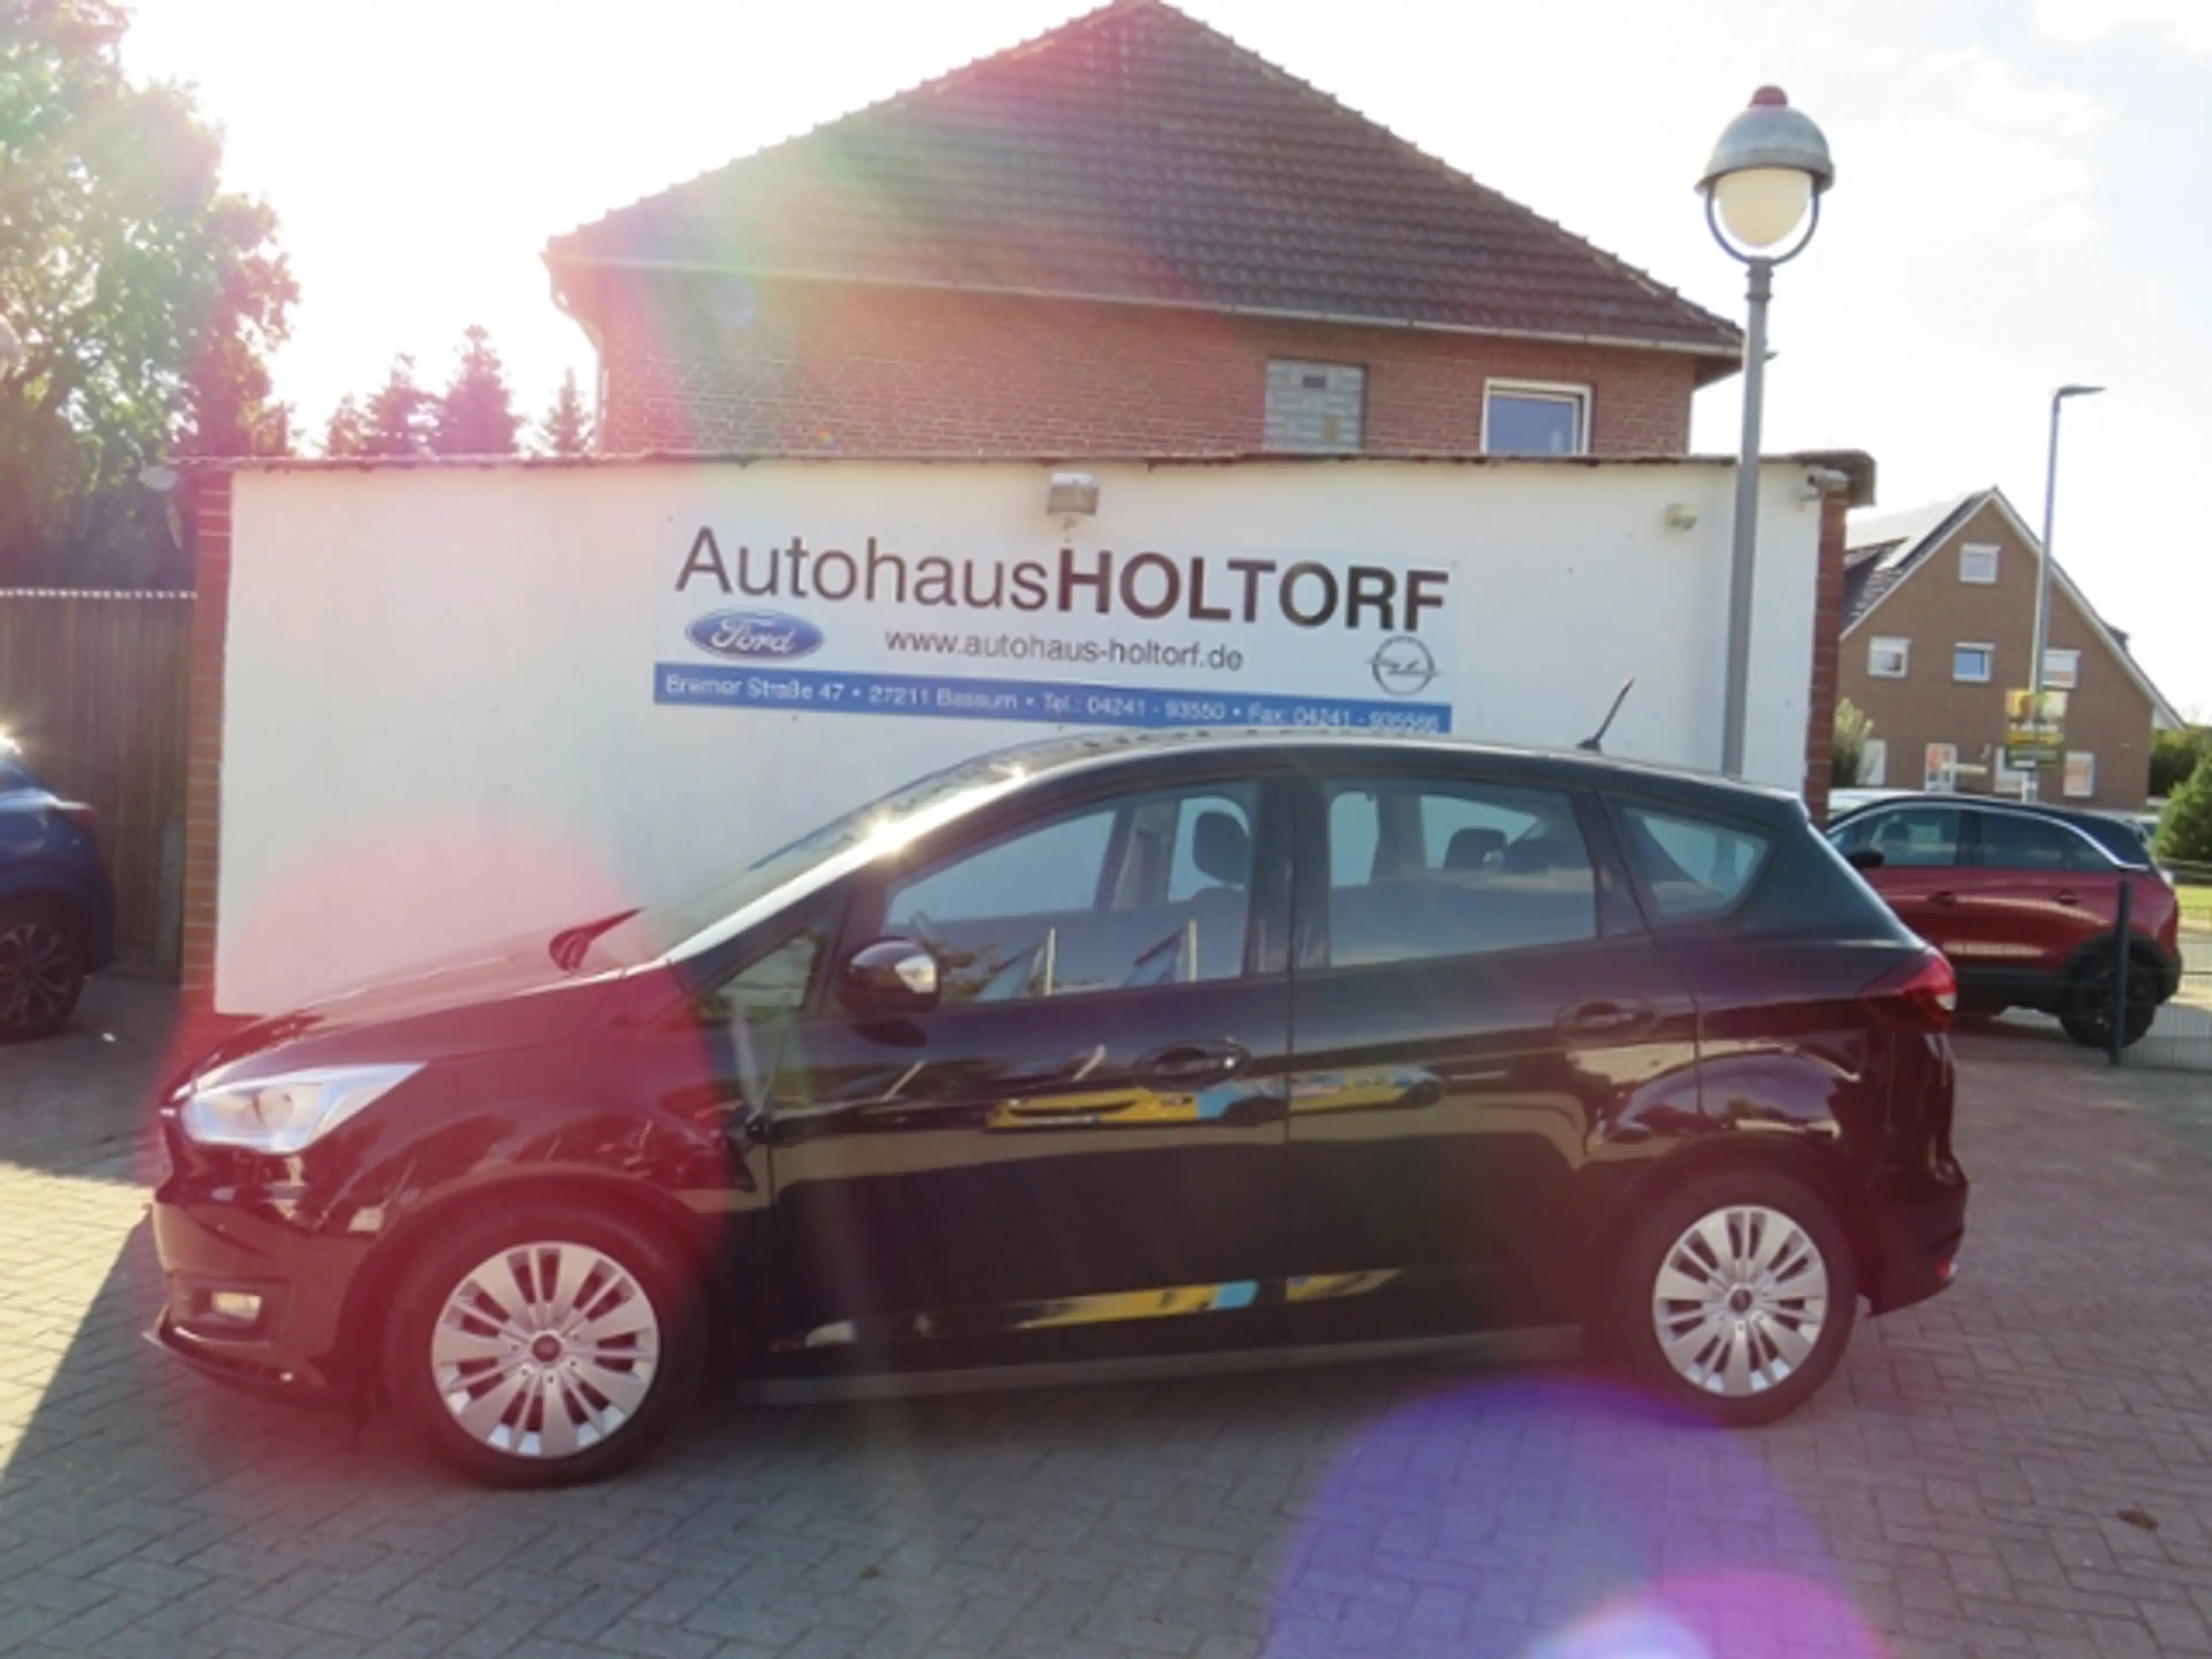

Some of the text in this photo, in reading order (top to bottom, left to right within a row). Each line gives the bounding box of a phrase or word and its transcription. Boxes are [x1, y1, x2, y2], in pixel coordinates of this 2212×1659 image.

[711, 618, 797, 654] Ford
[884, 628, 1244, 672] www.autohaus-holtorf.de
[817, 683, 845, 702] 47
[868, 684, 928, 706] 27211
[1086, 694, 1146, 717] 04241
